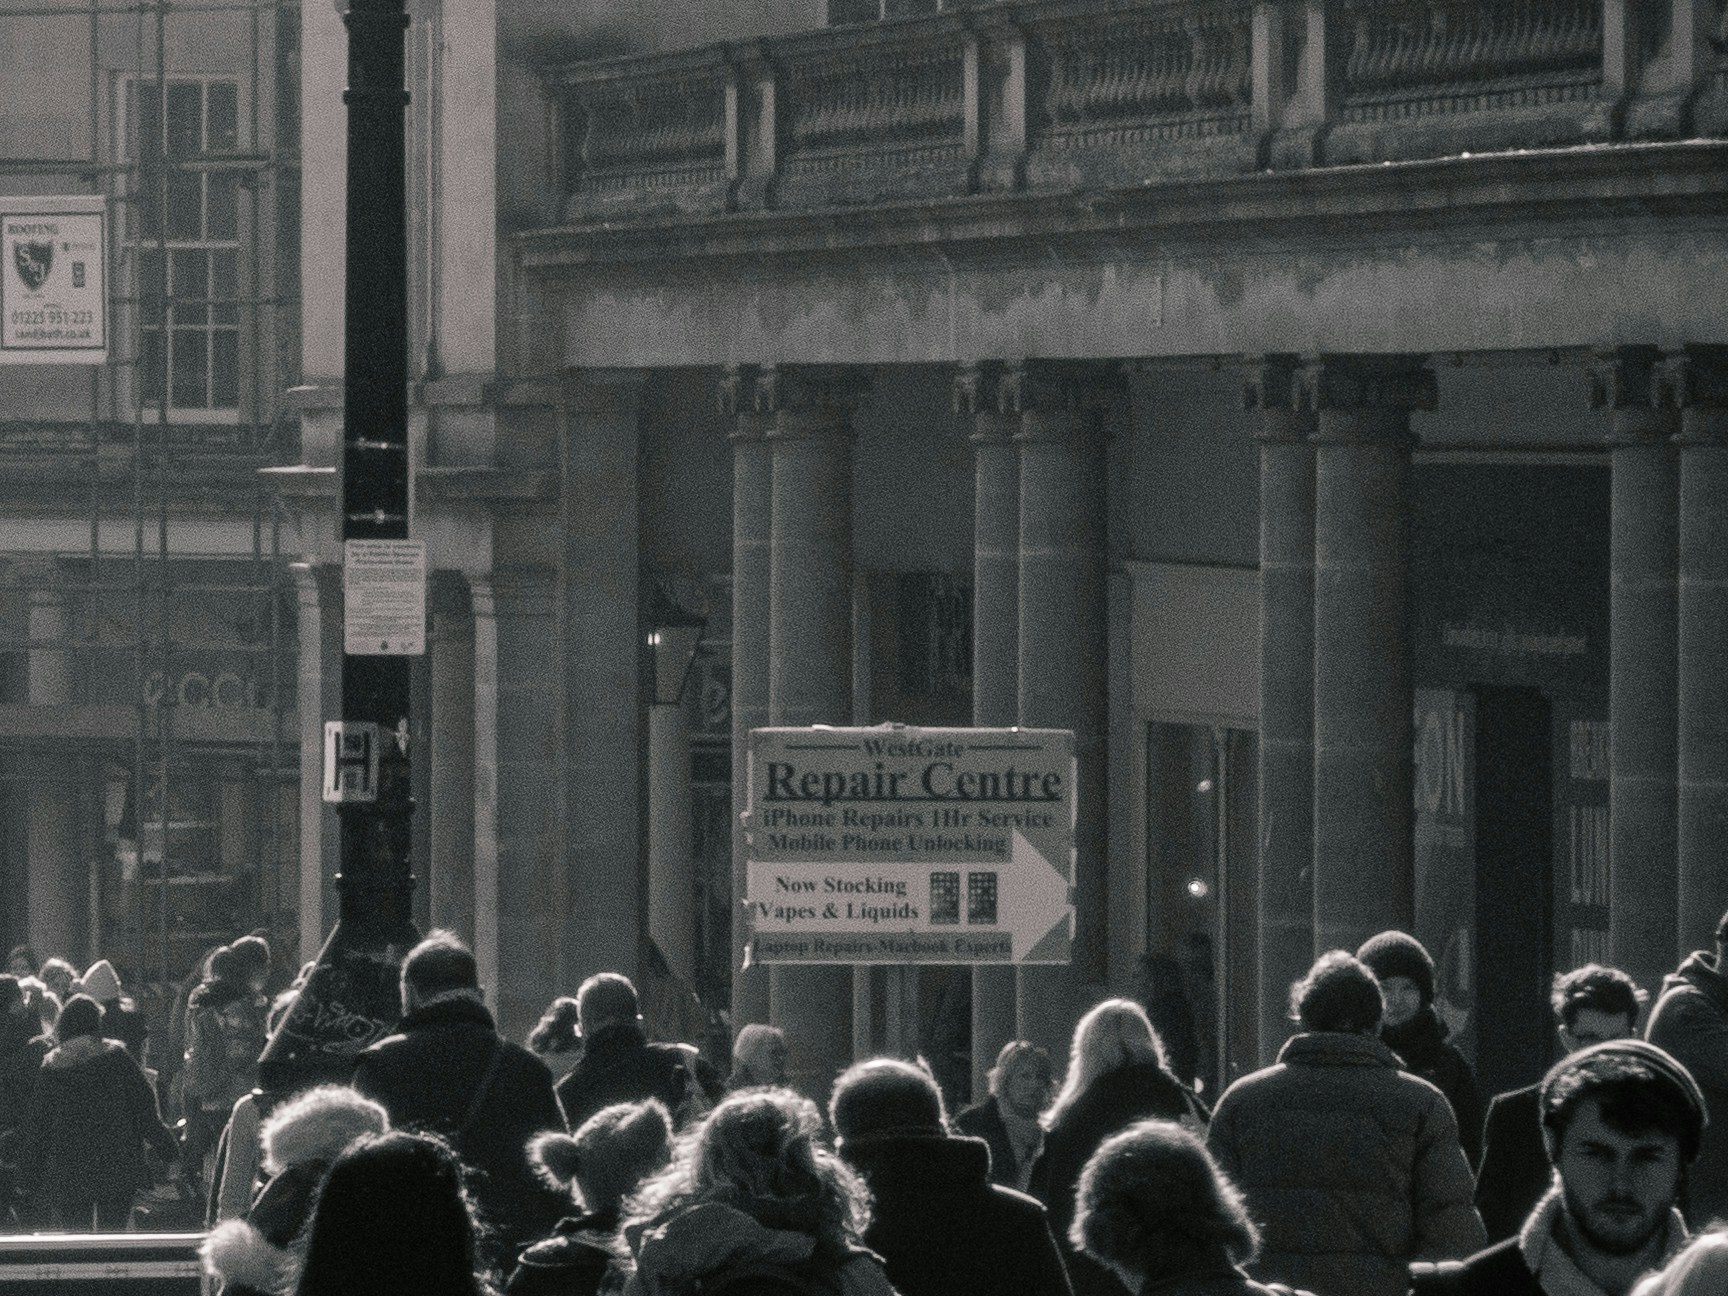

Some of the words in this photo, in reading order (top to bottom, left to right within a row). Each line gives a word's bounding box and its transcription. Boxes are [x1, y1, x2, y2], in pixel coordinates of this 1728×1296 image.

[864, 740, 964, 758] WestGate
[334, 732, 371, 792] H
[766, 762, 907, 806] Repair
[921, 762, 1062, 800] Centre
[763, 809, 836, 828] iPhone
[842, 809, 924, 831] Repairs
[931, 809, 972, 828] 1Hr
[978, 809, 1054, 828] Service
[767, 834, 836, 852] Mobile
[842, 834, 902, 852] Phone
[908, 833, 1007, 855] Unlocking
[775, 877, 818, 893] Now
[823, 877, 907, 897] Stocking
[759, 902, 816, 923] Vapes
[823, 902, 839, 919] &
[846, 902, 919, 923] Liquids
